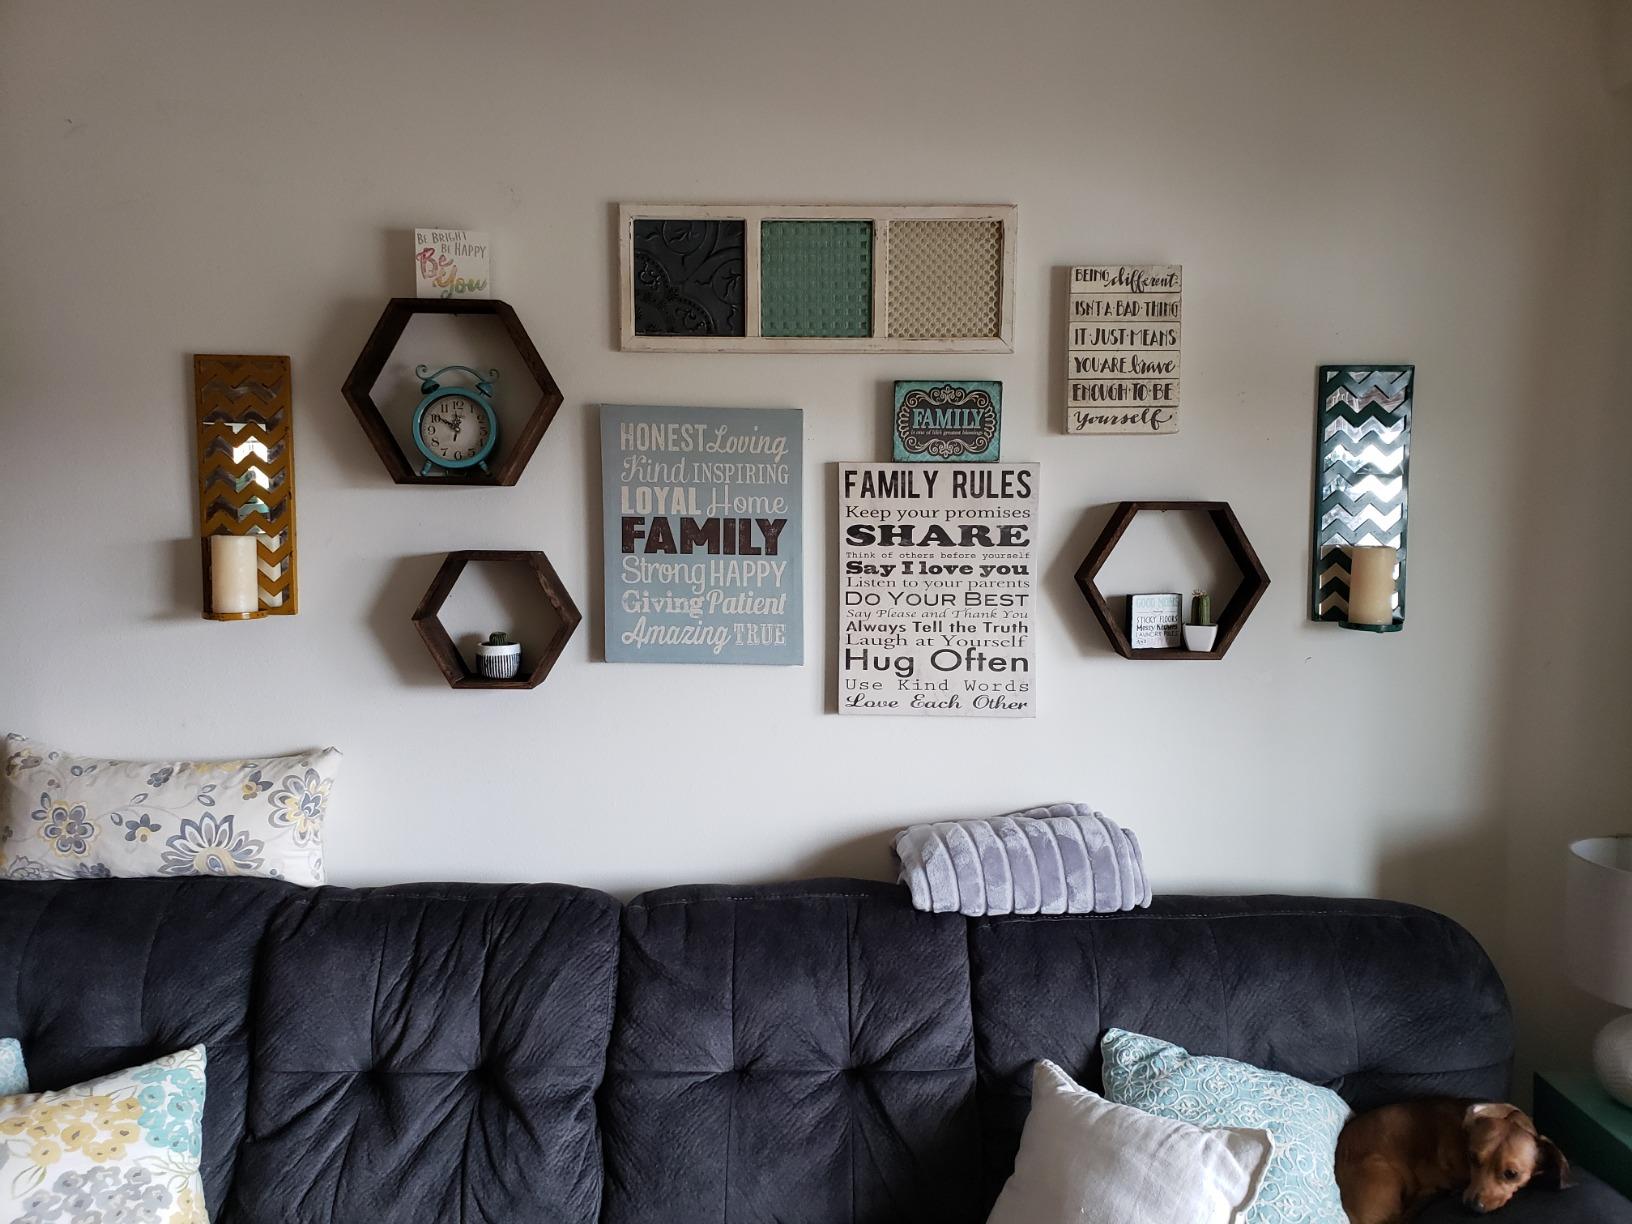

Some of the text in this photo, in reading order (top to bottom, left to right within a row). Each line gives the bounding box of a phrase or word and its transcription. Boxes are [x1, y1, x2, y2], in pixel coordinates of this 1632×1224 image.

[455, 242, 486, 259] HAPPY
[416, 248, 454, 279] Be
[432, 264, 488, 298] You
[1075, 266, 1179, 293] BEING different
[1116, 301, 1140, 317] BAD
[1144, 301, 1178, 318] THING
[1074, 328, 1177, 346] IT JUST MEANS
[1128, 354, 1176, 375] brave
[1072, 383, 1174, 401] ENOUGH TO BE
[441, 404, 448, 413] 11
[453, 401, 464, 410] 12
[431, 414, 440, 424] 10
[912, 408, 985, 429] FAMILY
[427, 425, 436, 436] 9
[431, 438, 440, 448] 8
[620, 422, 788, 463] HONEST Loving
[440, 447, 449, 457] 7
[454, 450, 462, 461] 6
[621, 454, 789, 484] Kind INSPIRING
[844, 470, 1032, 499] FAMILY RULES
[621, 485, 788, 517] LOYAL Home
[846, 505, 1031, 522] Keep your promises
[621, 516, 788, 555] FAMILY
[846, 524, 1031, 547] SHARE
[846, 551, 1031, 561] Think of others before yourself
[621, 555, 787, 594] Strong HAPPY
[846, 561, 1030, 578] Say I love you
[847, 577, 1031, 592] Listen to your parents
[621, 589, 787, 619] Giving Patient
[846, 608, 1029, 621] Say Please and Thank You
[621, 615, 786, 654] Amazing TRUE
[846, 620, 1029, 634] Always Tell the Truth
[846, 634, 1029, 650] Laugh at Yourself
[845, 647, 1029, 678] Hug Often
[845, 678, 1030, 692] Use Kind Words
[846, 692, 1028, 711] Love Each Other
